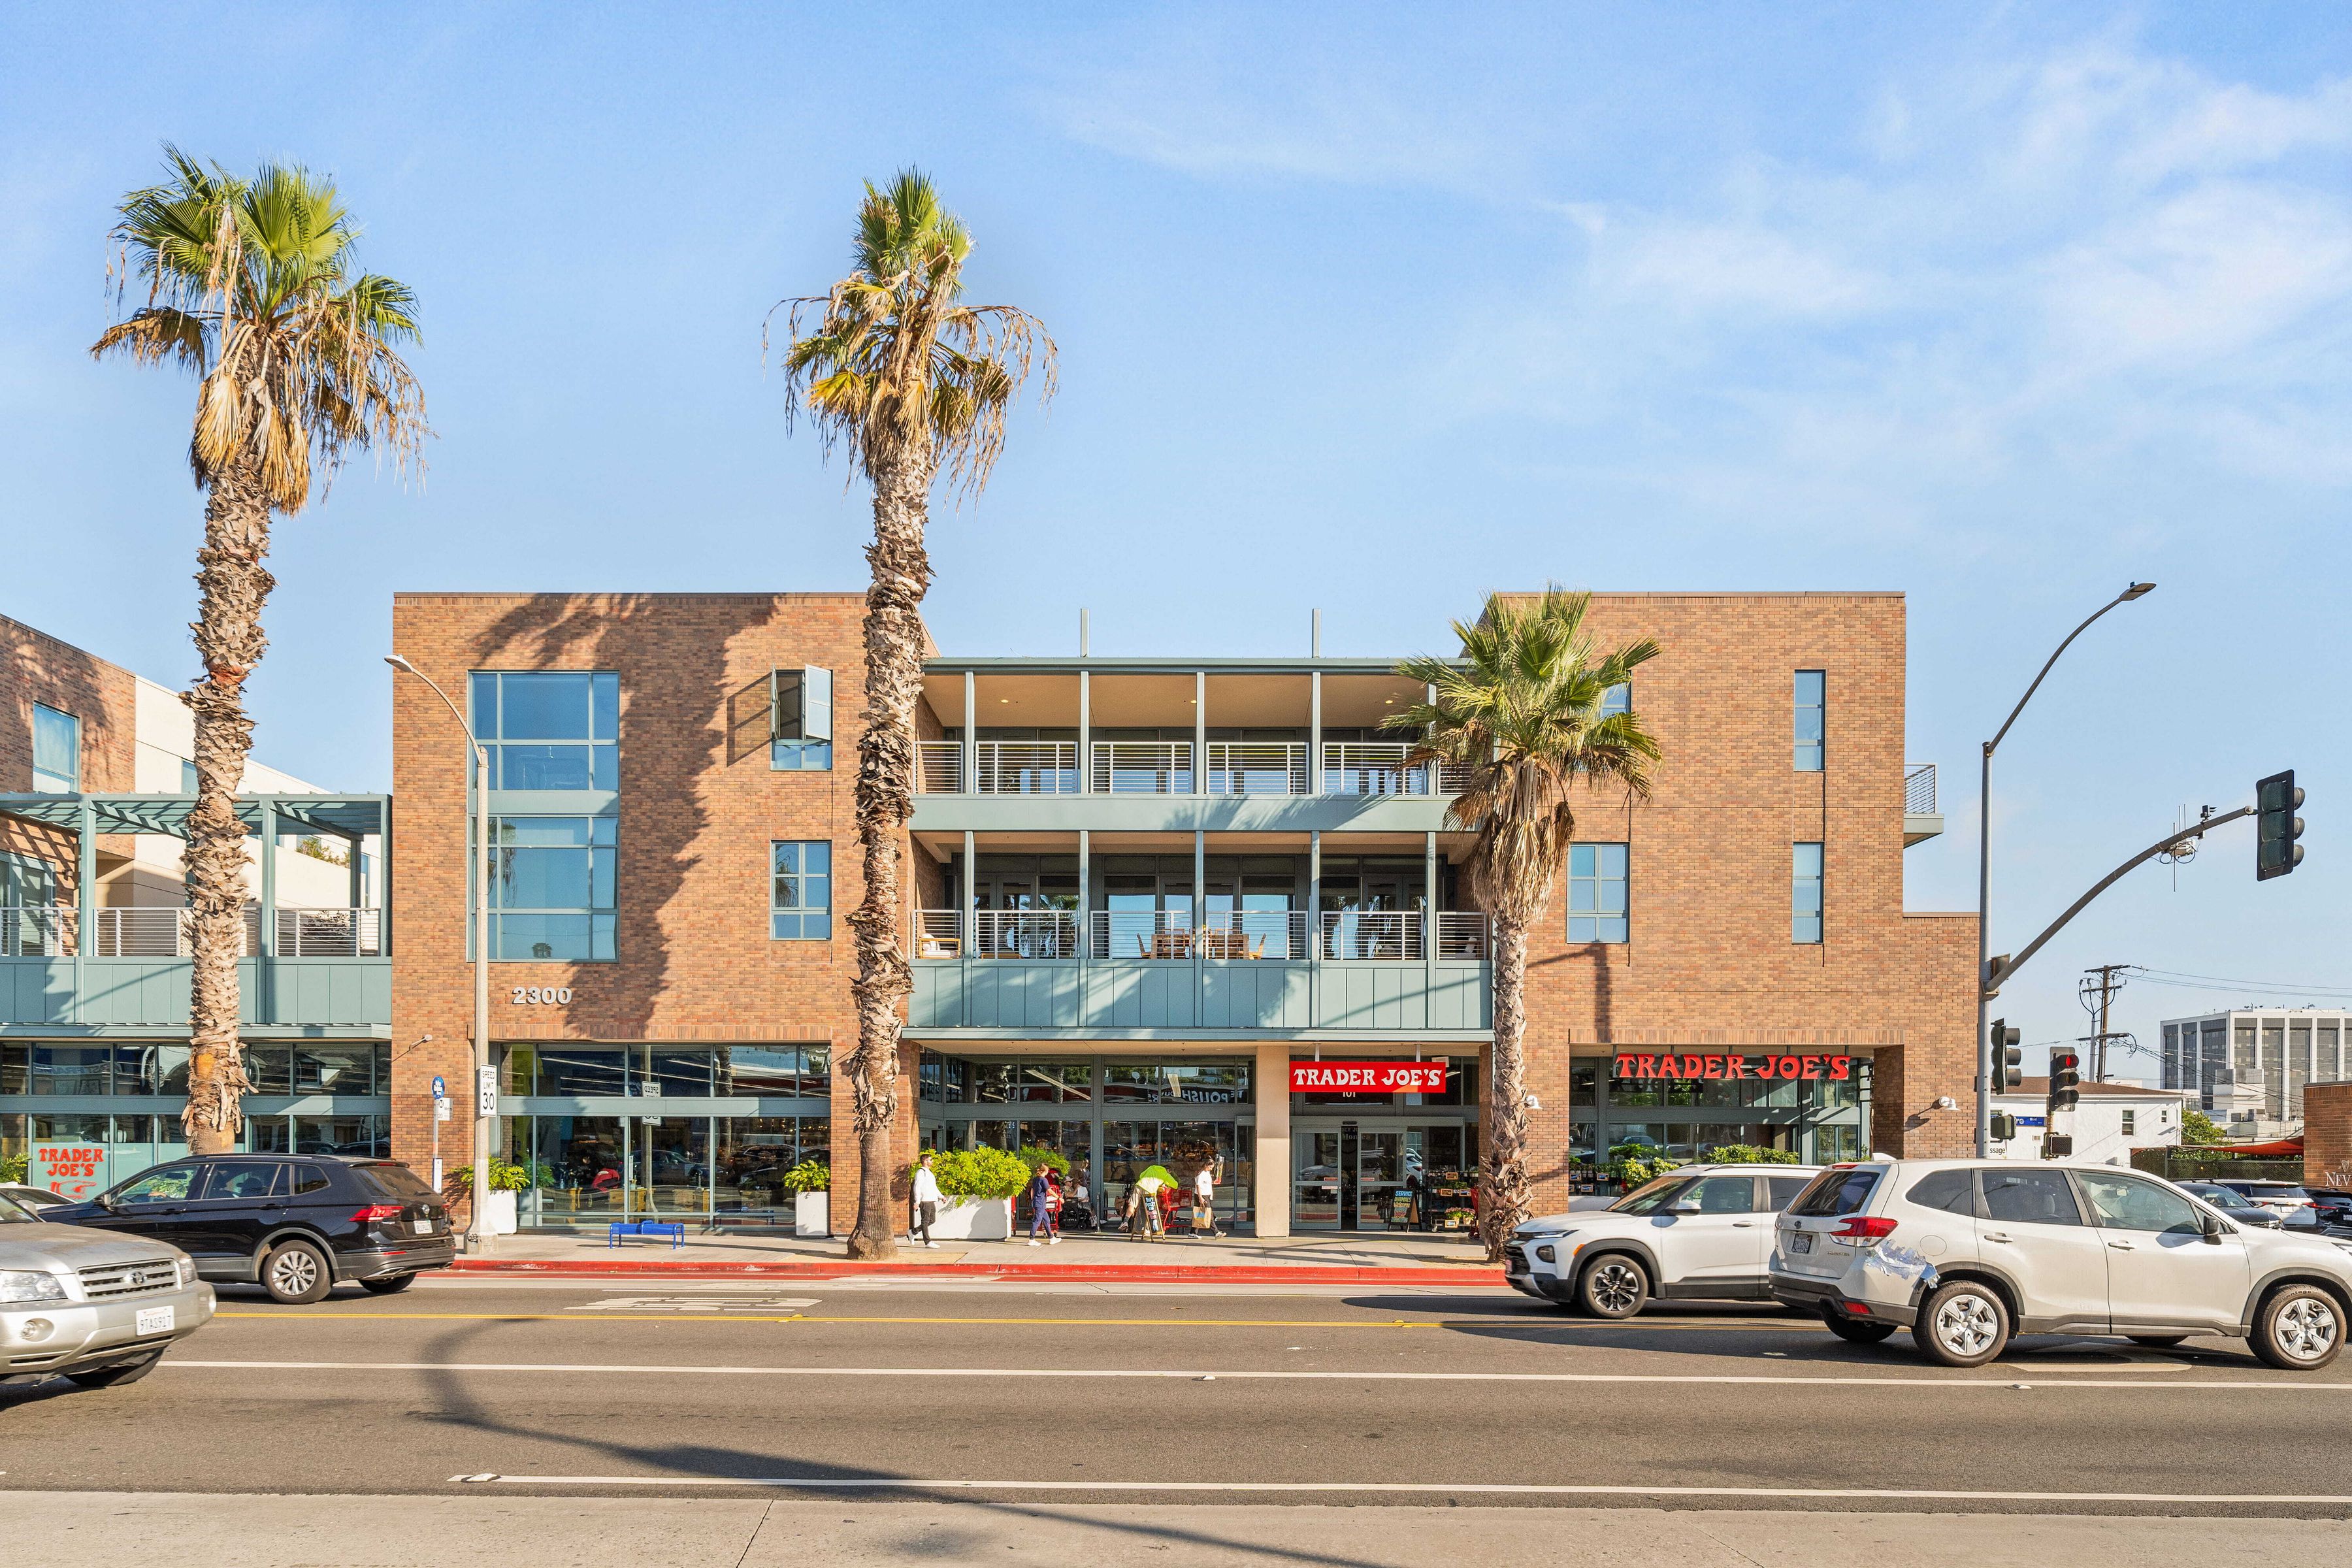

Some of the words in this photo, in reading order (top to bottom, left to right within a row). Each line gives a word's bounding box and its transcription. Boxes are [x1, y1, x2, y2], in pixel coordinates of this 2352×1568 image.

[512, 987, 572, 1004] 2300
[1615, 1054, 1746, 1078] TRADER
[1755, 1053, 1851, 1079] JOE'S
[482, 1071, 495, 1079] SPEED
[1293, 1069, 1376, 1086] TRADER
[1380, 1068, 1443, 1086] JOE'S
[483, 1092, 495, 1110] 30
[39, 1149, 104, 1162] TRADER
[46, 1163, 95, 1177] JOE'S
